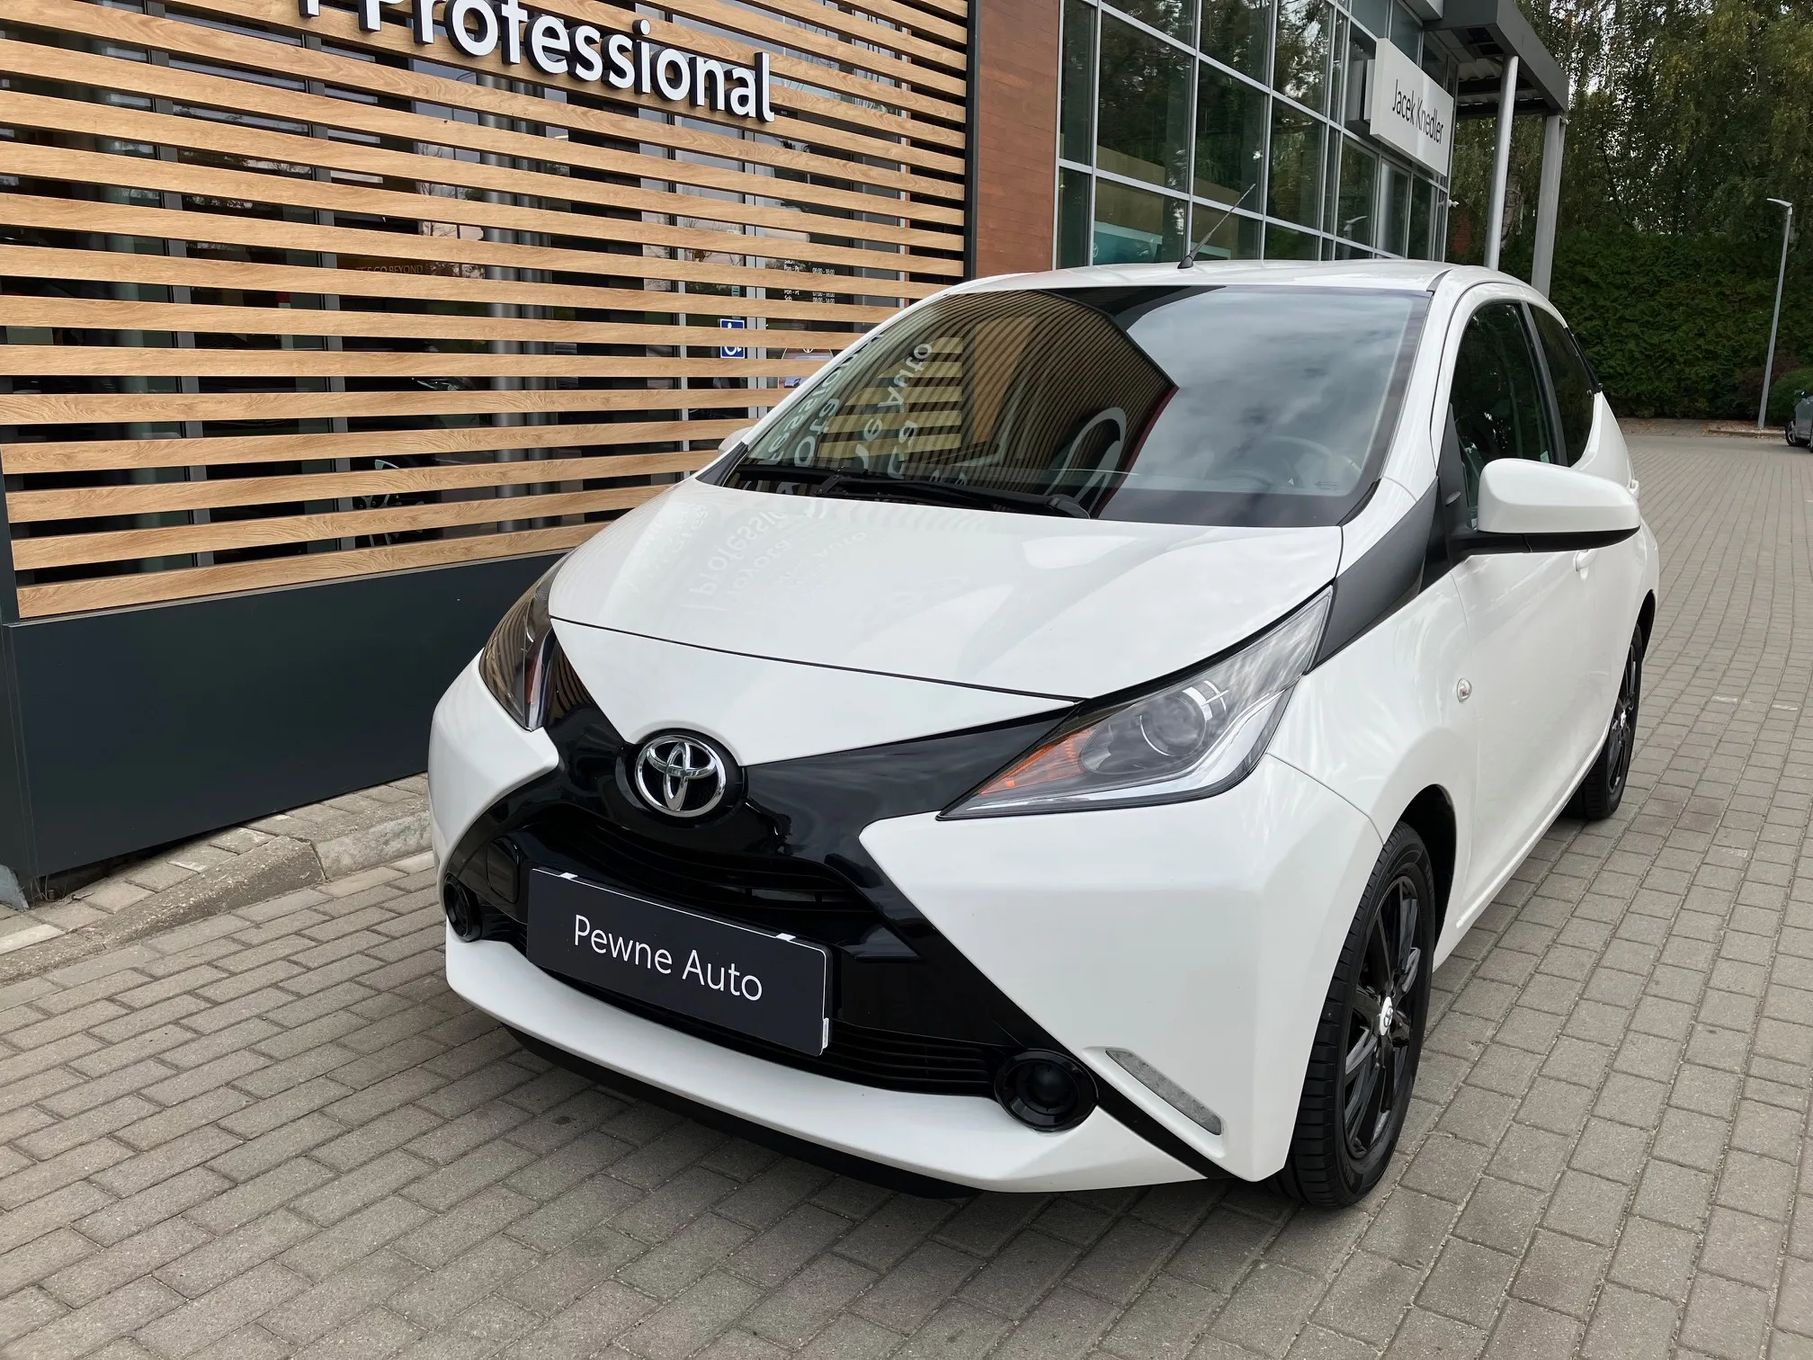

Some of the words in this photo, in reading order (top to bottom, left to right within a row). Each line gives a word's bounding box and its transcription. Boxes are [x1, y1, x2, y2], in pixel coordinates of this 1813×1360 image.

[1392, 79, 1415, 125] Jacek
[1415, 97, 1443, 144] Knedler
[574, 914, 673, 974] Pewne
[682, 949, 762, 1001] Auto
